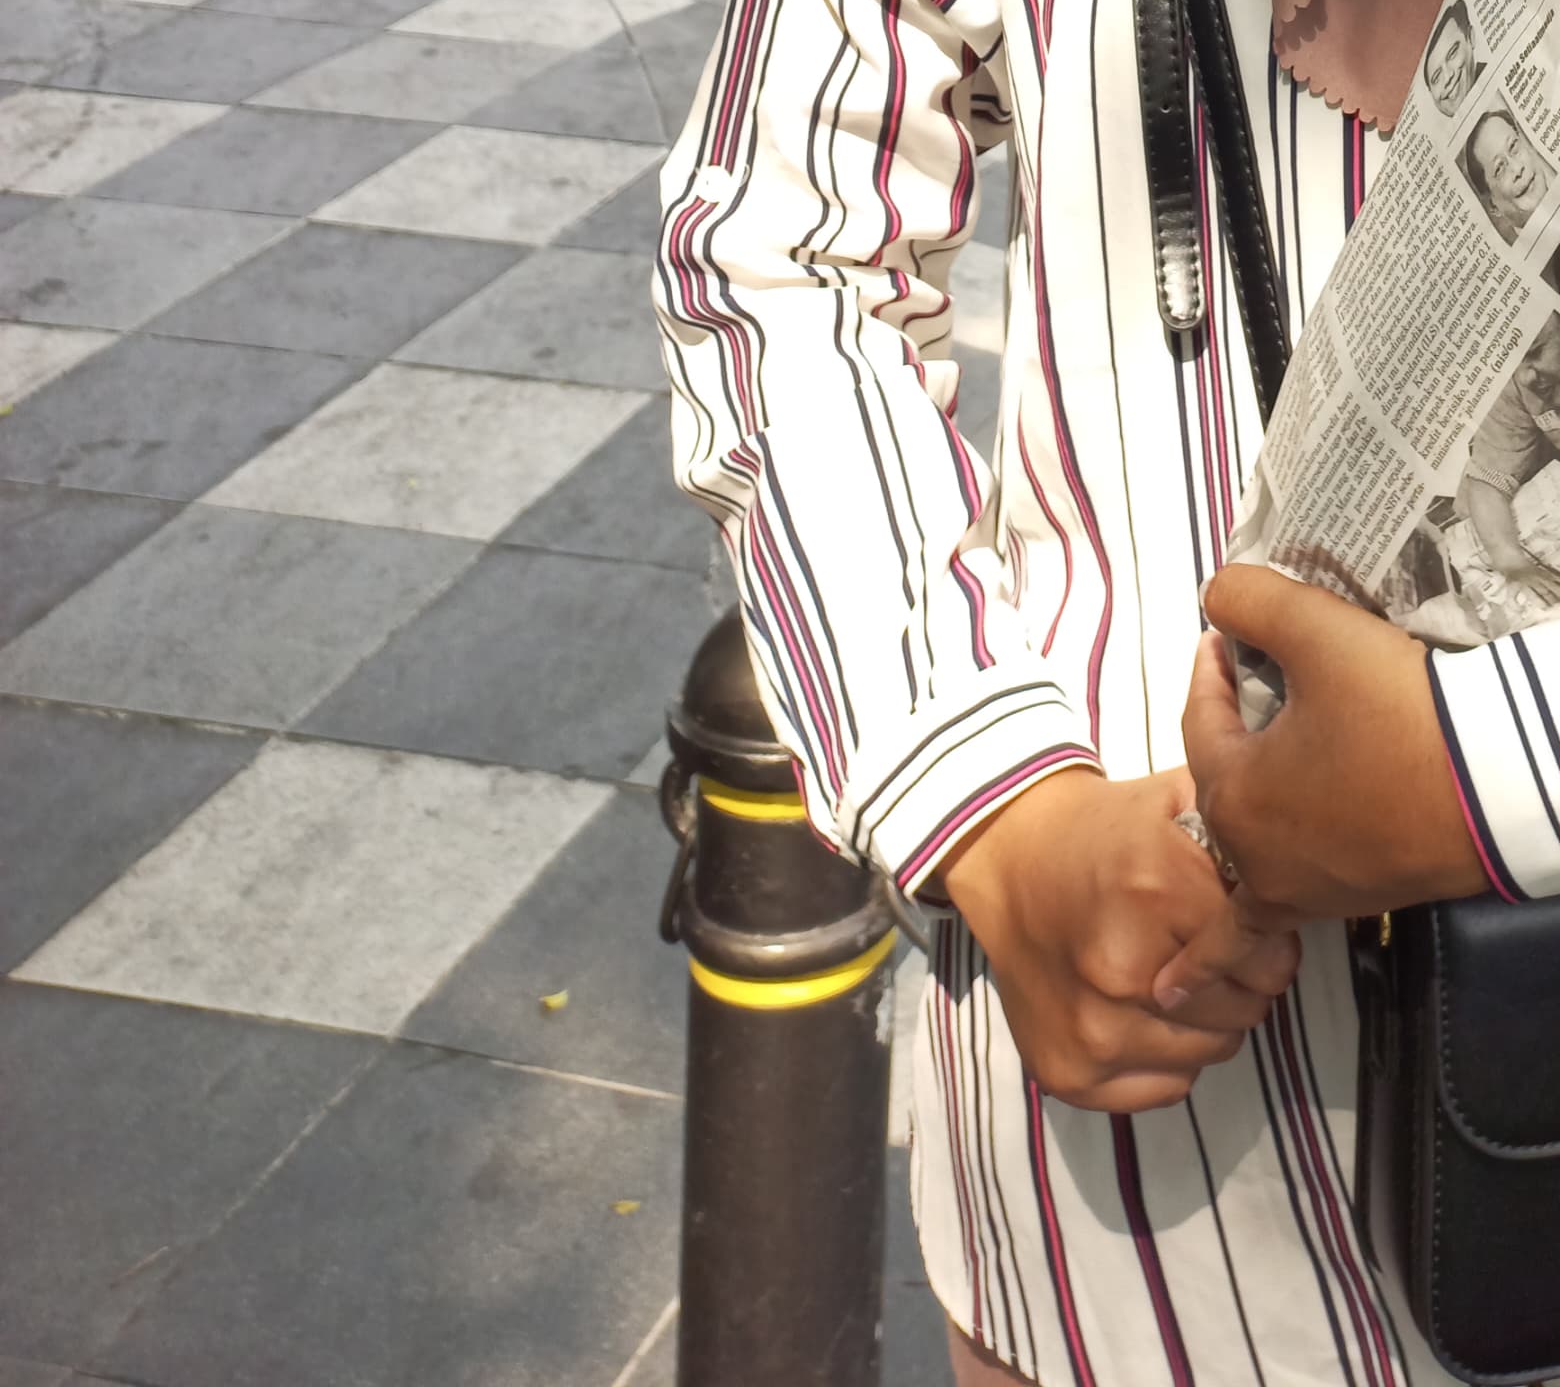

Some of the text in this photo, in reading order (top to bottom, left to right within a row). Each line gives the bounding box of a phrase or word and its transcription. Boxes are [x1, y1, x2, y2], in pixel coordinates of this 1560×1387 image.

[1408, 139, 1433, 179] kuartal
[1365, 222, 1476, 392] tat dibandingkan periode sebelumnya.
[1381, 285, 1420, 346] diperkirakan
[1421, 250, 1442, 285] sedikit
[1441, 226, 1460, 251] lebih
[1388, 365, 1399, 380] ini
[1397, 313, 1431, 364] terindikasi
[1431, 290, 1445, 312] dari
[1443, 255, 1467, 289] Indeks
[1466, 232, 1483, 255] Len-
[1399, 262, 1420, 294] kredit
[1421, 236, 1439, 264] pada
[1438, 194, 1464, 235] kuartal
[1381, 393, 1398, 415] ding
[1394, 347, 1424, 394] Standard
[1422, 324, 1439, 351] (ILS)
[1438, 290, 1458, 327] positif
[1457, 257, 1480, 295] sebesar
[1390, 252, 1500, 428] persen. Kebijakan penyaluran kredit
[1399, 264, 1511, 437] diperkirakan lebih ketat, antara lain
[1410, 275, 1521, 450] pada aspek suku bunga kredit, premi
[1417, 286, 1530, 459] kredit berisiko, dan persyaratan ad-
[1465, 376, 1494, 418] jelasnya.
[1491, 327, 1522, 372] (nis/opi)
